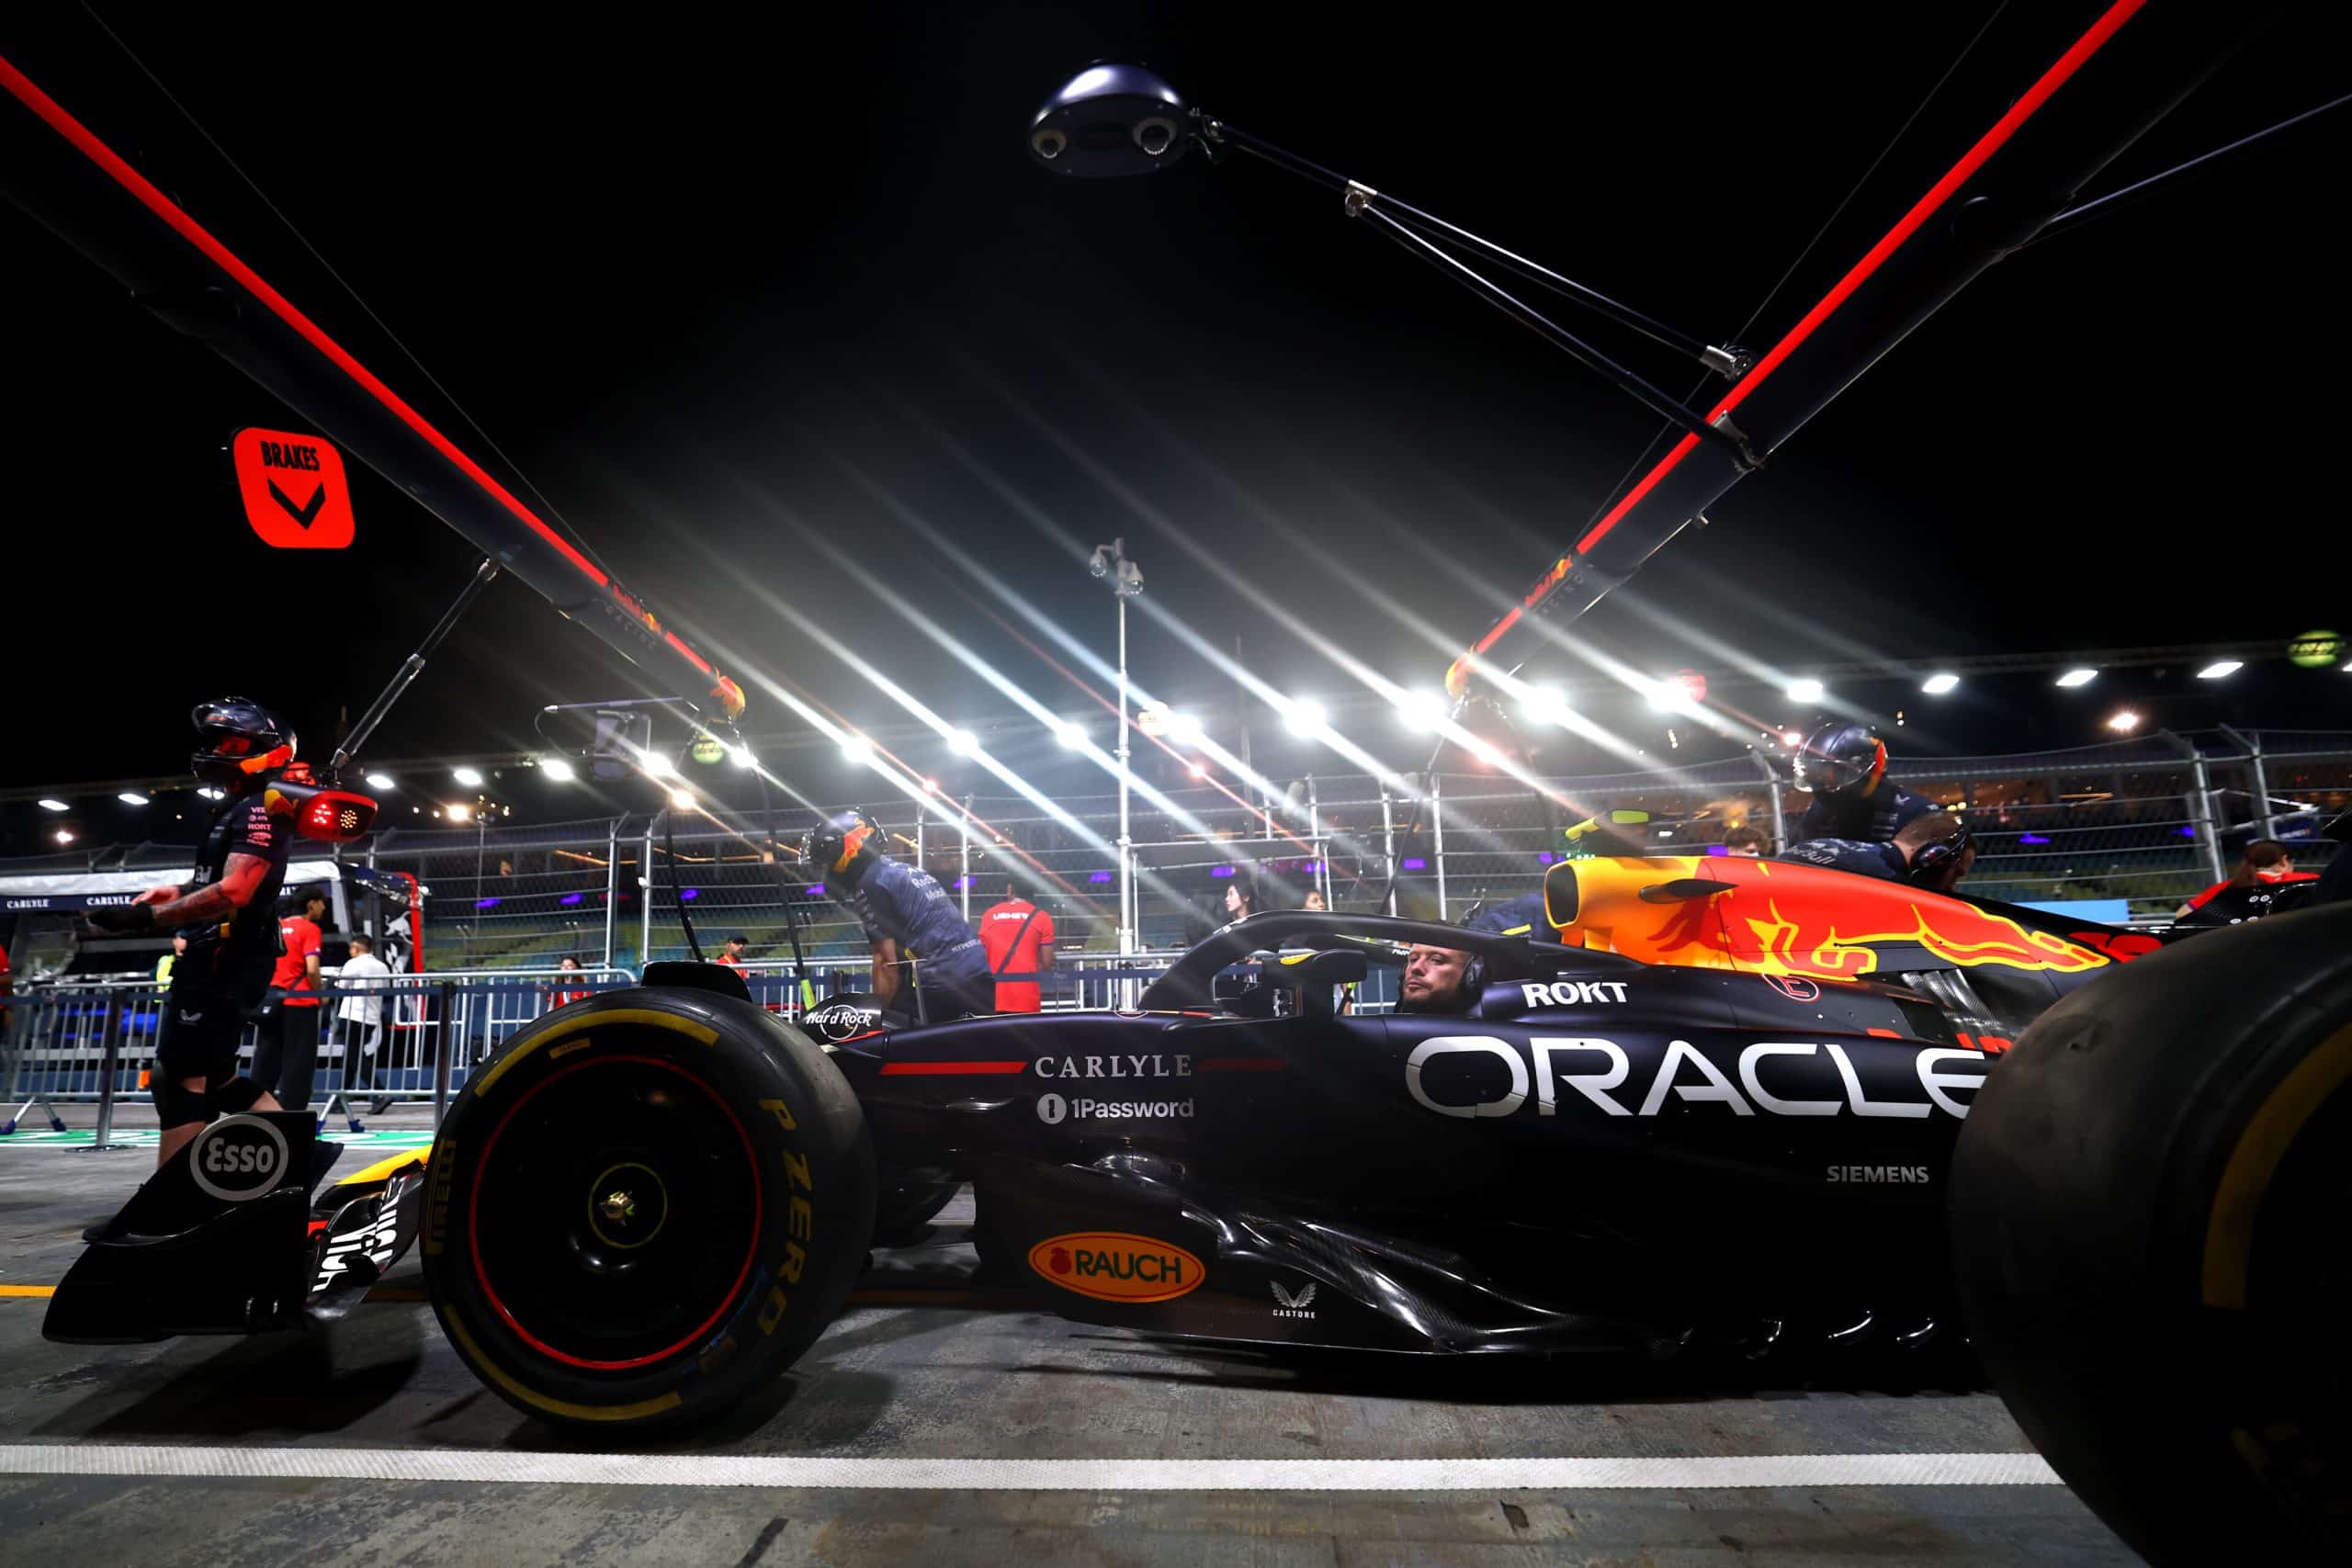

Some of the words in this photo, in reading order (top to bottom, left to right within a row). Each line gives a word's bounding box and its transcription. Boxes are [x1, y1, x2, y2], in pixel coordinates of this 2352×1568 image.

[261, 440, 320, 471] BRAKES
[1521, 981, 1629, 1009] ROKT
[806, 1011, 838, 1024] Hard
[840, 1011, 872, 1026] Rock
[1035, 1055, 1192, 1078] CARLYLE
[1405, 1035, 1985, 1119] ORACLE
[759, 1099, 797, 1131] P
[1071, 1098, 1194, 1119] 1Password
[1826, 1166, 1929, 1183] SIEMENS
[756, 1153, 812, 1337] ZERO
[1075, 1249, 1182, 1284] RAUCH
